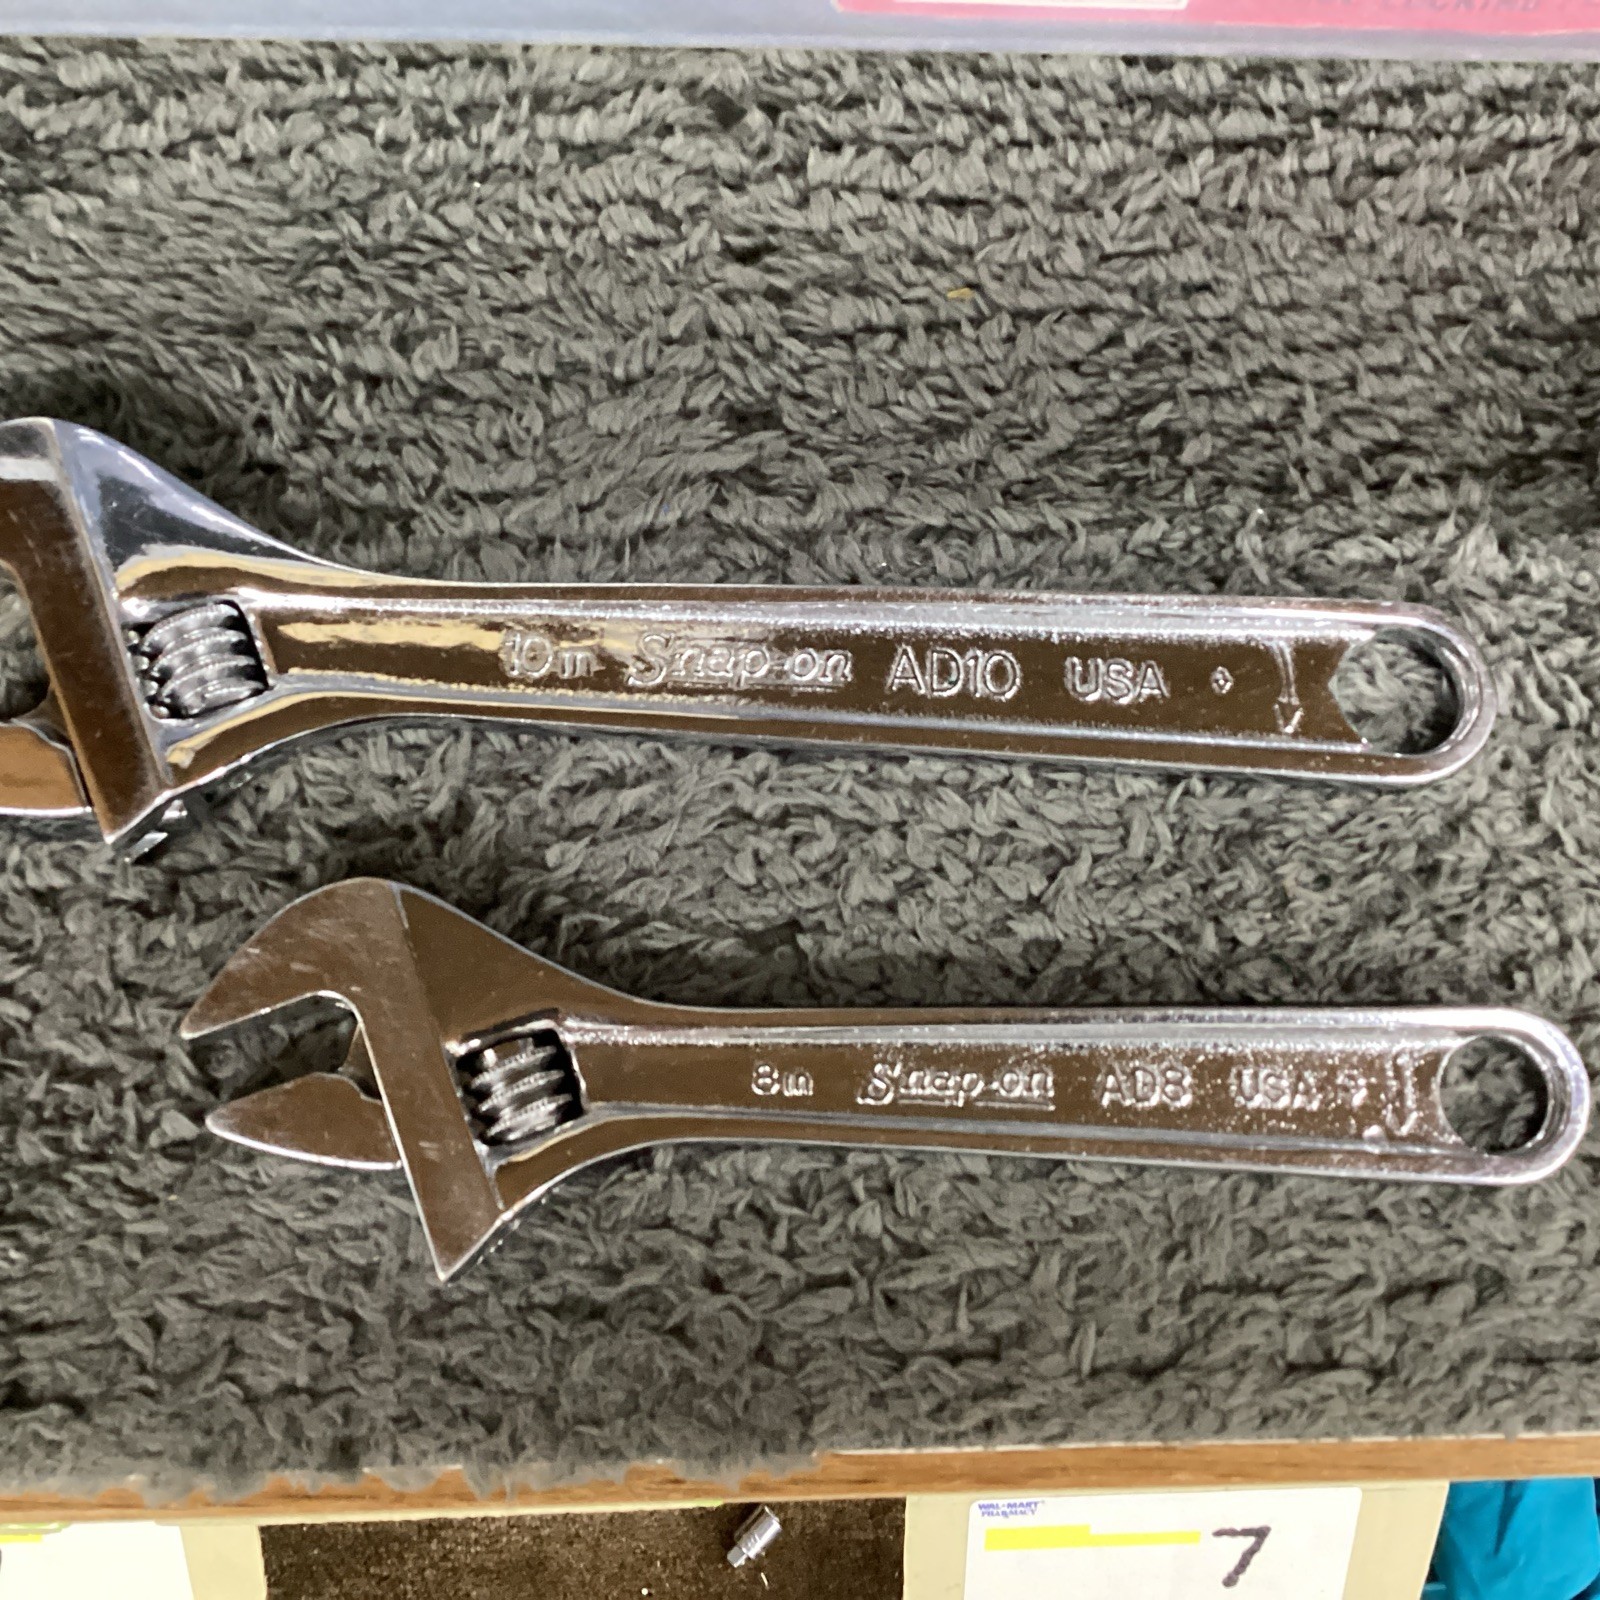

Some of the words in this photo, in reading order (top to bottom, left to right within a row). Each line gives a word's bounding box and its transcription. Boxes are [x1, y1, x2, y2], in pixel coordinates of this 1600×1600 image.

[625, 633, 853, 693] Snap-on
[885, 643, 1023, 702] AD10
[1064, 655, 1171, 705] USA
[855, 1062, 1056, 1111] Snap-on
[1099, 1062, 1193, 1110] AD8
[1230, 1066, 1320, 1112] USA
[1212, 1525, 1271, 1588] 7
